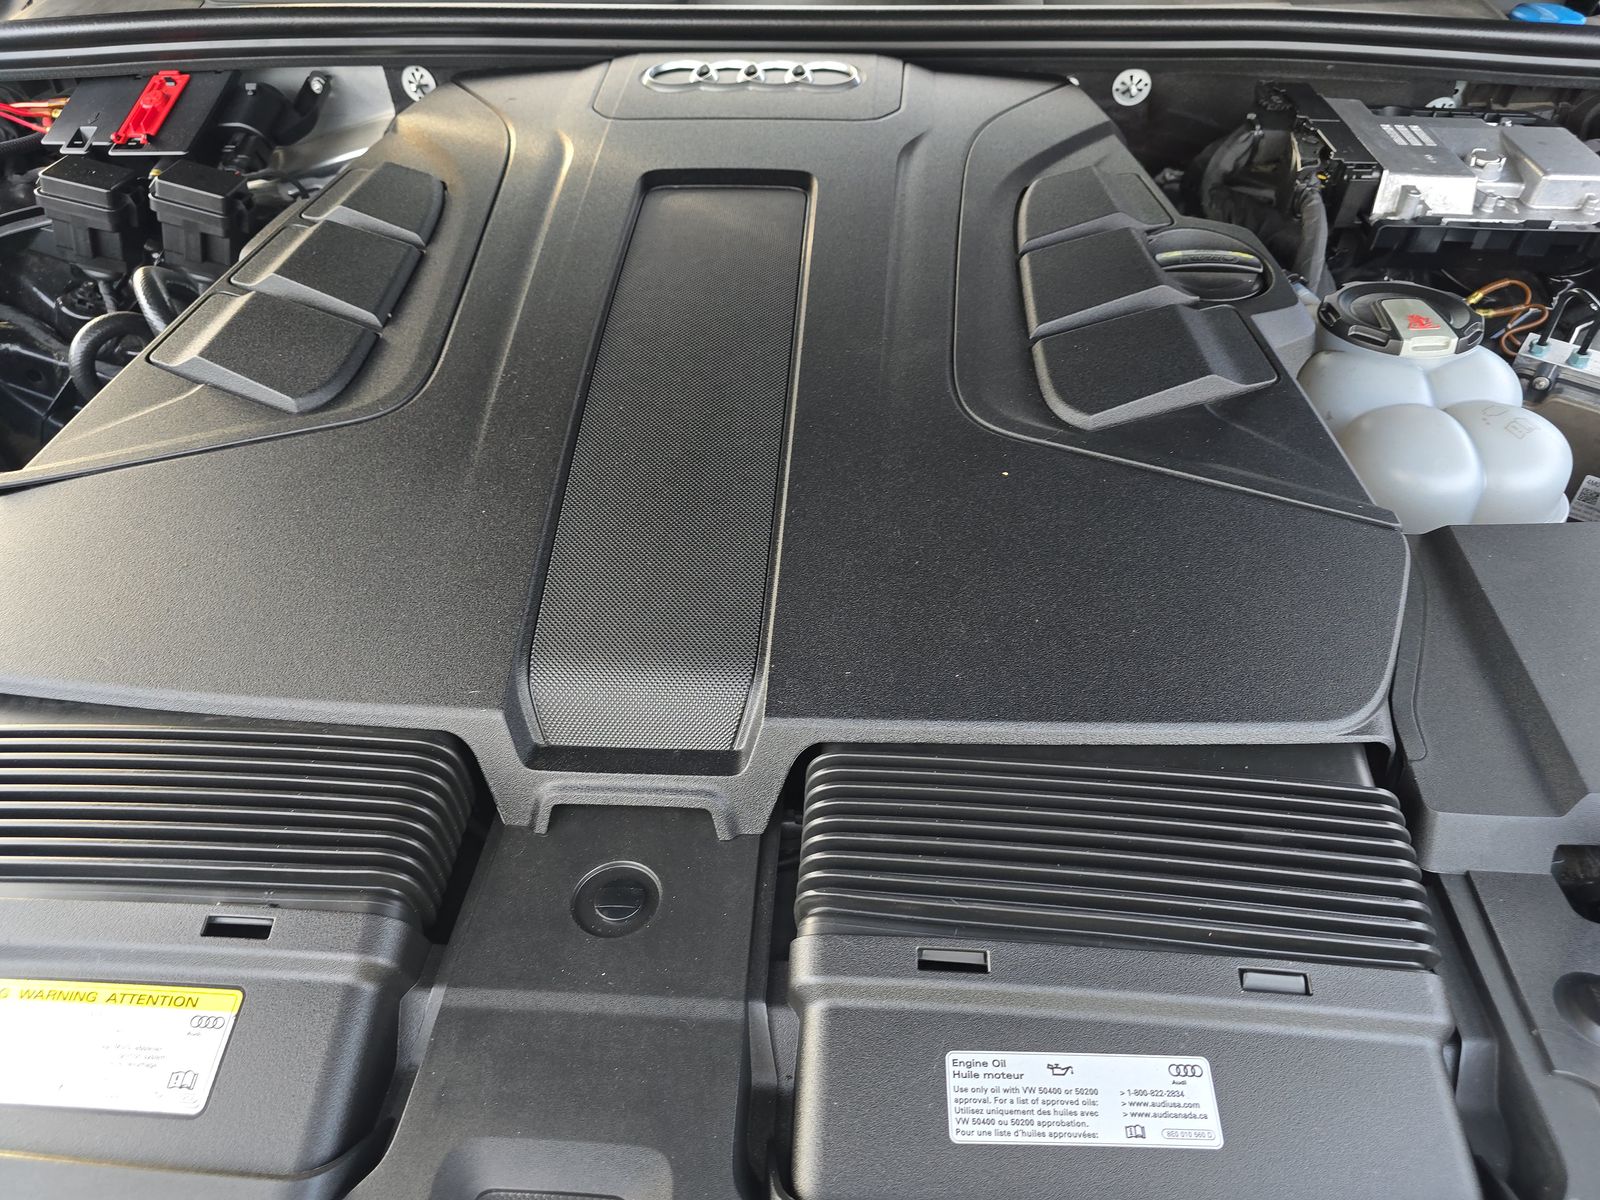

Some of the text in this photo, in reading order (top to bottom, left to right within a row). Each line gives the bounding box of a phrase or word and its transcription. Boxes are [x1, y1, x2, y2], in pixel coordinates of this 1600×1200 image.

[19, 988, 99, 1003] WARNING
[105, 992, 199, 1008] ATTENTION
[952, 1058, 1007, 1069] Engine Oil
[952, 1070, 1024, 1080] Huile moteur
[953, 1085, 969, 1093] Use
[970, 1085, 988, 1095] only
[990, 1086, 1001, 1094] oil
[1002, 1086, 1020, 1094] with
[1021, 1086, 1037, 1094] VW
[1038, 1086, 1062, 1095] 50400
[1074, 1087, 1099, 1096] 50200
[953, 1096, 992, 1105] approval.
[993, 1096, 1007, 1104] For
[1016, 1096, 1029, 1105] list
[1030, 1097, 1039, 1105] of
[1041, 1097, 1079, 1106] approved
[1081, 1098, 1099, 1106] oils:
[1127, 1100, 1200, 1109] www.audiusa.com
[954, 1106, 984, 1115] Utilisez
[986, 1106, 1035, 1116] uniquement
[1036, 1108, 1051, 1116] des
[1053, 1108, 1078, 1116] huiles
[1129, 1110, 1208, 1120] www.audicanada.ca
[955, 1117, 970, 1125] VW
[971, 1117, 996, 1126] 50400
[1010, 1118, 1035, 1127] 50200
[1036, 1119, 1090, 1128] approbation.
[955, 1128, 975, 1136] Pour
[976, 1129, 992, 1137] une
[994, 1128, 1012, 1137] liste
[1048, 1130, 1099, 1139] approuvées:
